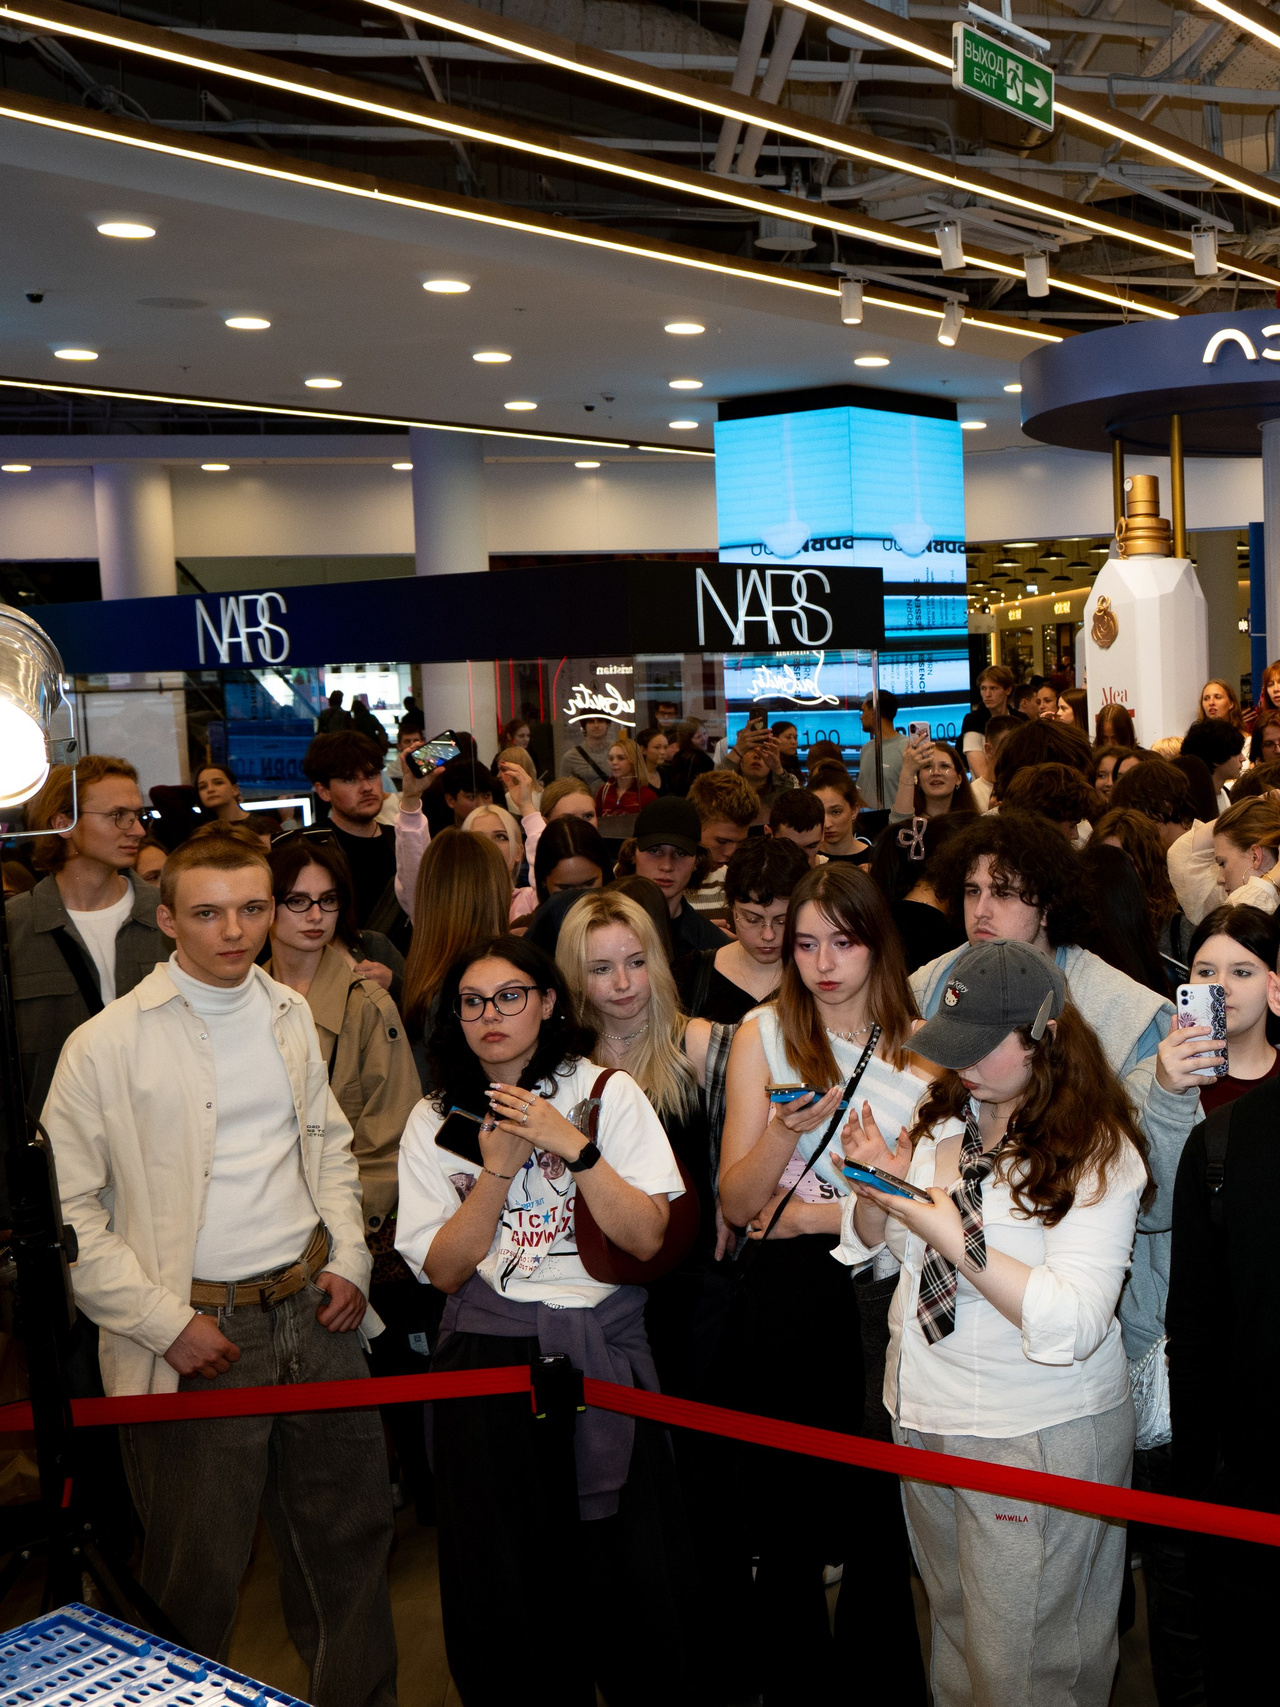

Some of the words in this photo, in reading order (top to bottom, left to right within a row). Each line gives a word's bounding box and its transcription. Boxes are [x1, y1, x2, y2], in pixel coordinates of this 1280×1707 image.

[965, 38, 1005, 79] ВЫХОД
[973, 66, 998, 90] EXIT
[695, 568, 833, 646] NARS
[914, 578, 922, 627] ESSENE
[195, 592, 290, 664] NARS
